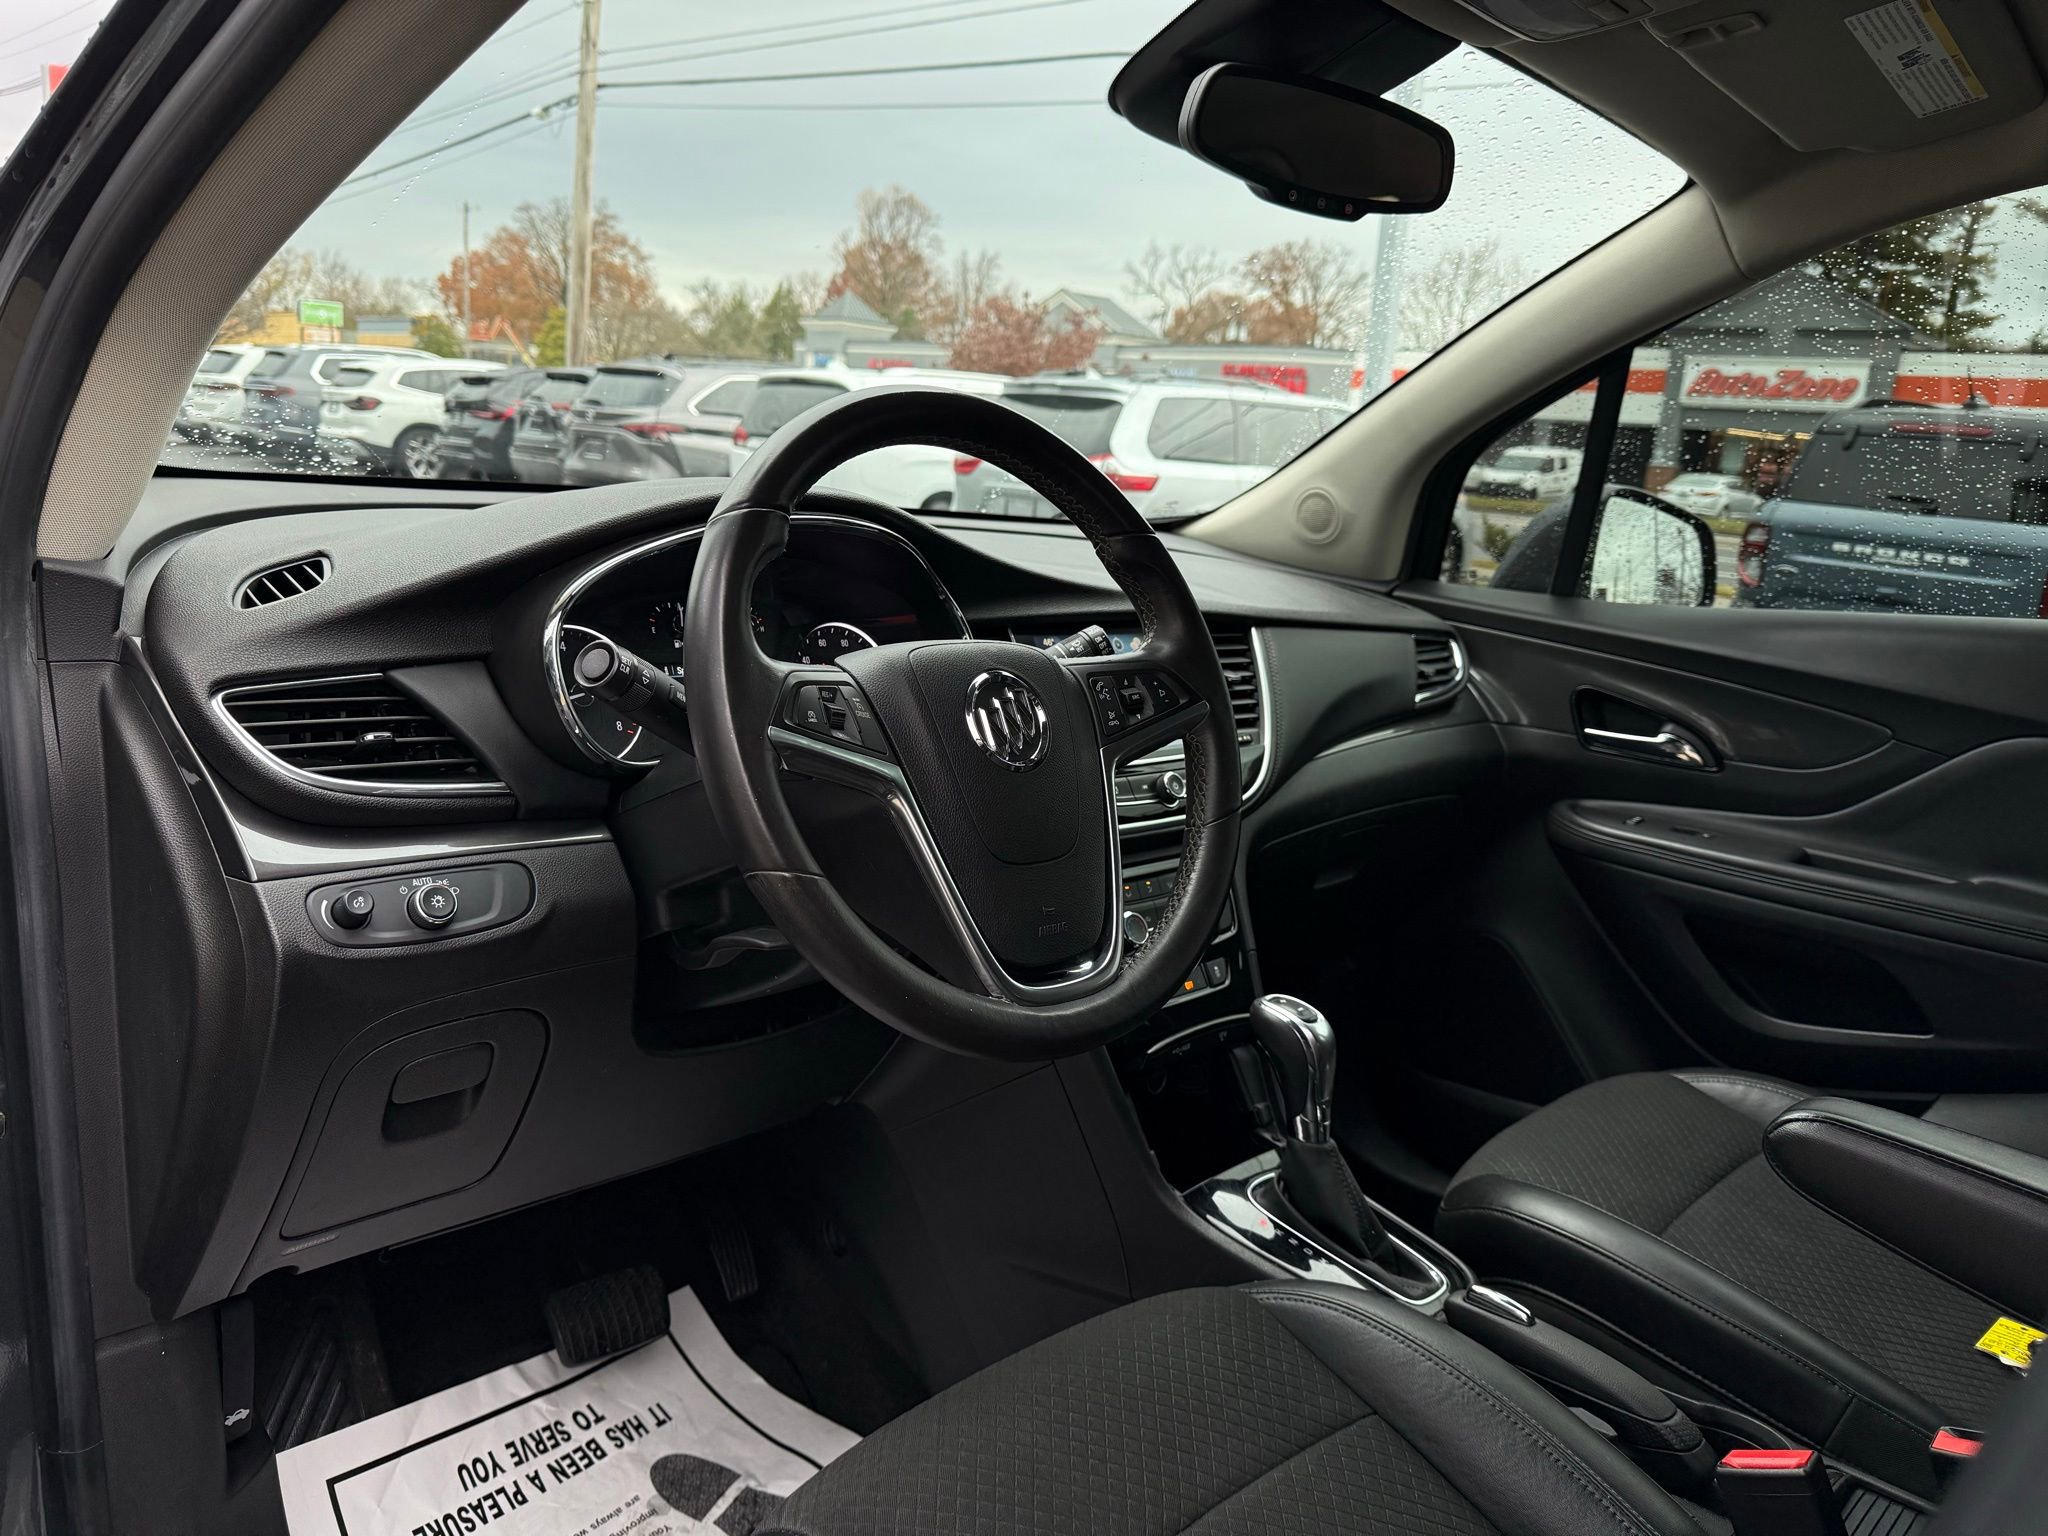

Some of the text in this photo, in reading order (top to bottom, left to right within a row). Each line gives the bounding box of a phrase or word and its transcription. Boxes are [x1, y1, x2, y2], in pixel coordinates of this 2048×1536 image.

[1686, 368, 1860, 401] AutoZone
[818, 639, 849, 647] 60 80
[616, 720, 623, 731] 8
[412, 877, 433, 887] AUTO
[648, 1402, 673, 1428] IT
[604, 1415, 650, 1449] HAS
[457, 1403, 607, 1492] TO SERVE YOU
[547, 1437, 608, 1484] BEEN
[525, 1469, 547, 1494] A
[625, 1494, 641, 1508] are
[590, 1506, 623, 1530] always
